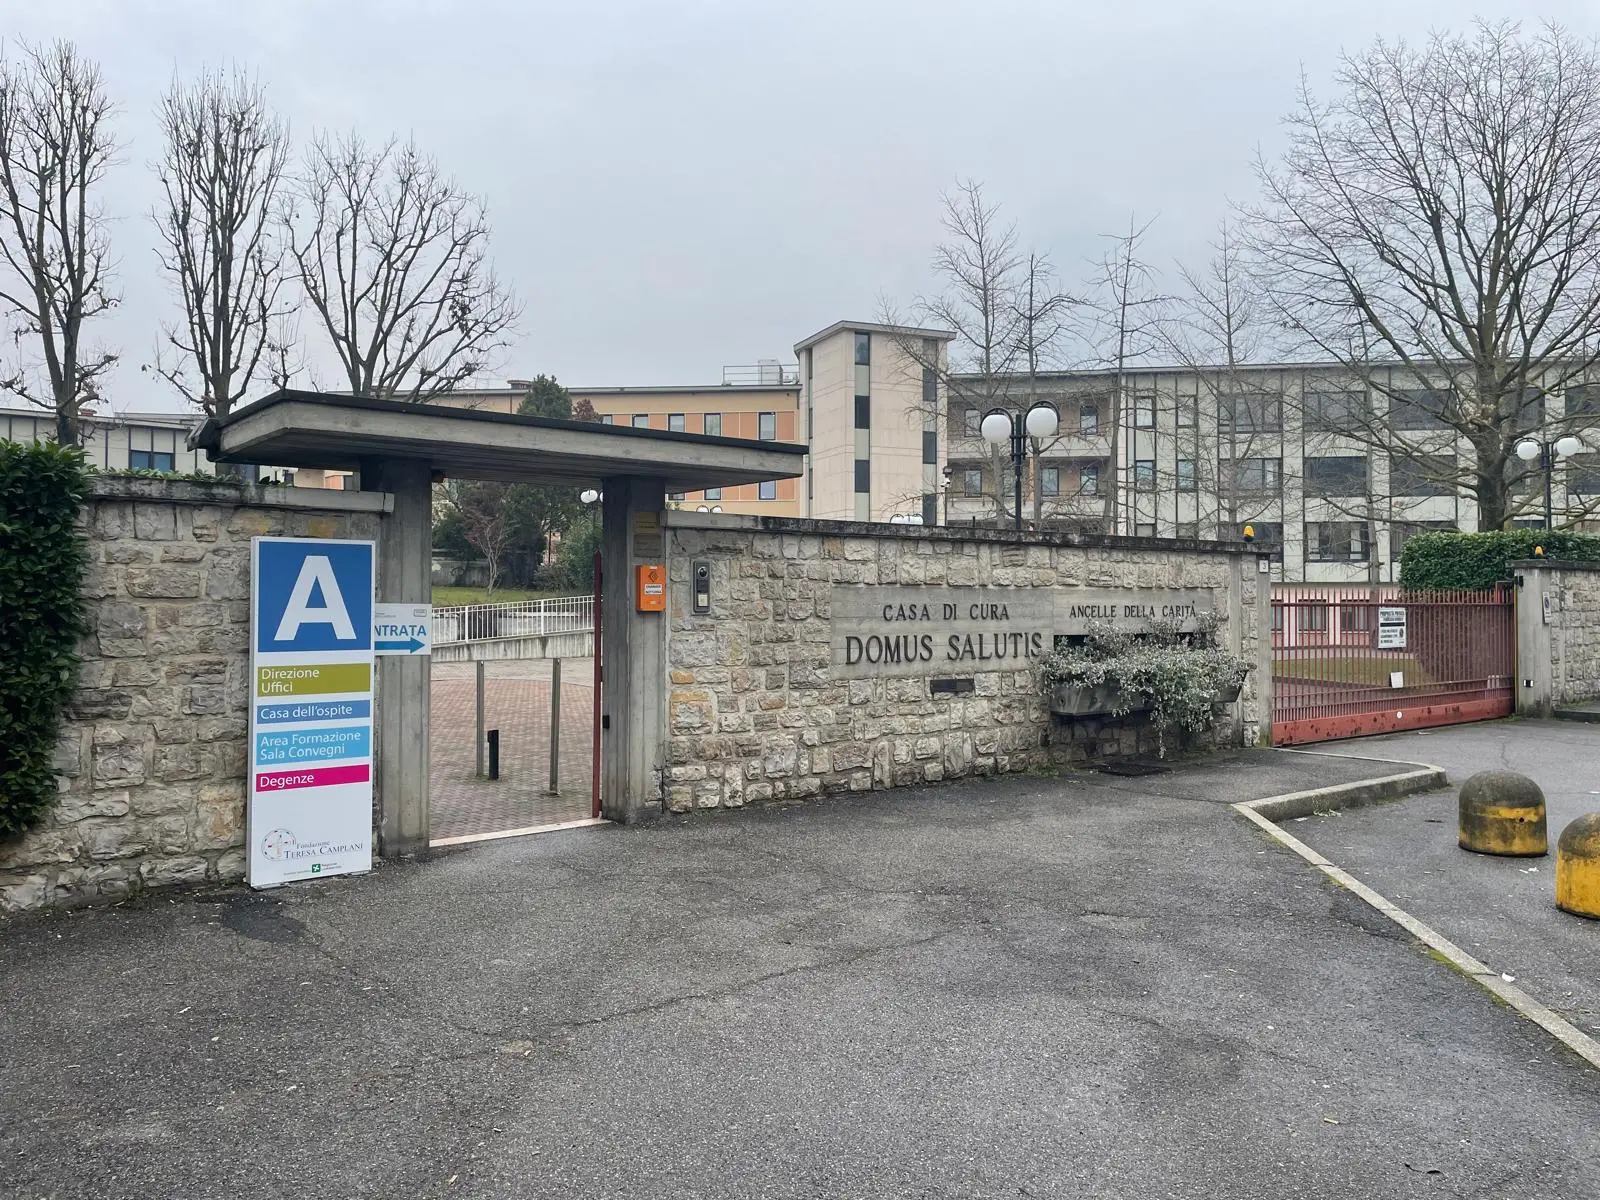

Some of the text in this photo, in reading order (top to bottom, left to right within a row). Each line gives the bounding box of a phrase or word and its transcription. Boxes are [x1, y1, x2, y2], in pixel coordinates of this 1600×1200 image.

[273, 555, 357, 641] A
[882, 603, 1010, 621] CASA DI CURA
[1068, 605, 1117, 618] ANCELLE
[1124, 605, 1156, 618] DELLA
[375, 625, 427, 637] NTRATA
[845, 631, 1043, 665] DOMUS SALUTIS
[261, 668, 320, 680] Direzione
[261, 682, 293, 693] Uffici
[260, 704, 353, 719] Casa dell'ospite
[260, 731, 361, 747] Area Formazione
[260, 744, 345, 760] Sala Convegni
[260, 774, 315, 788] Degenze
[284, 842, 363, 859] TERESA CAMPLANI
